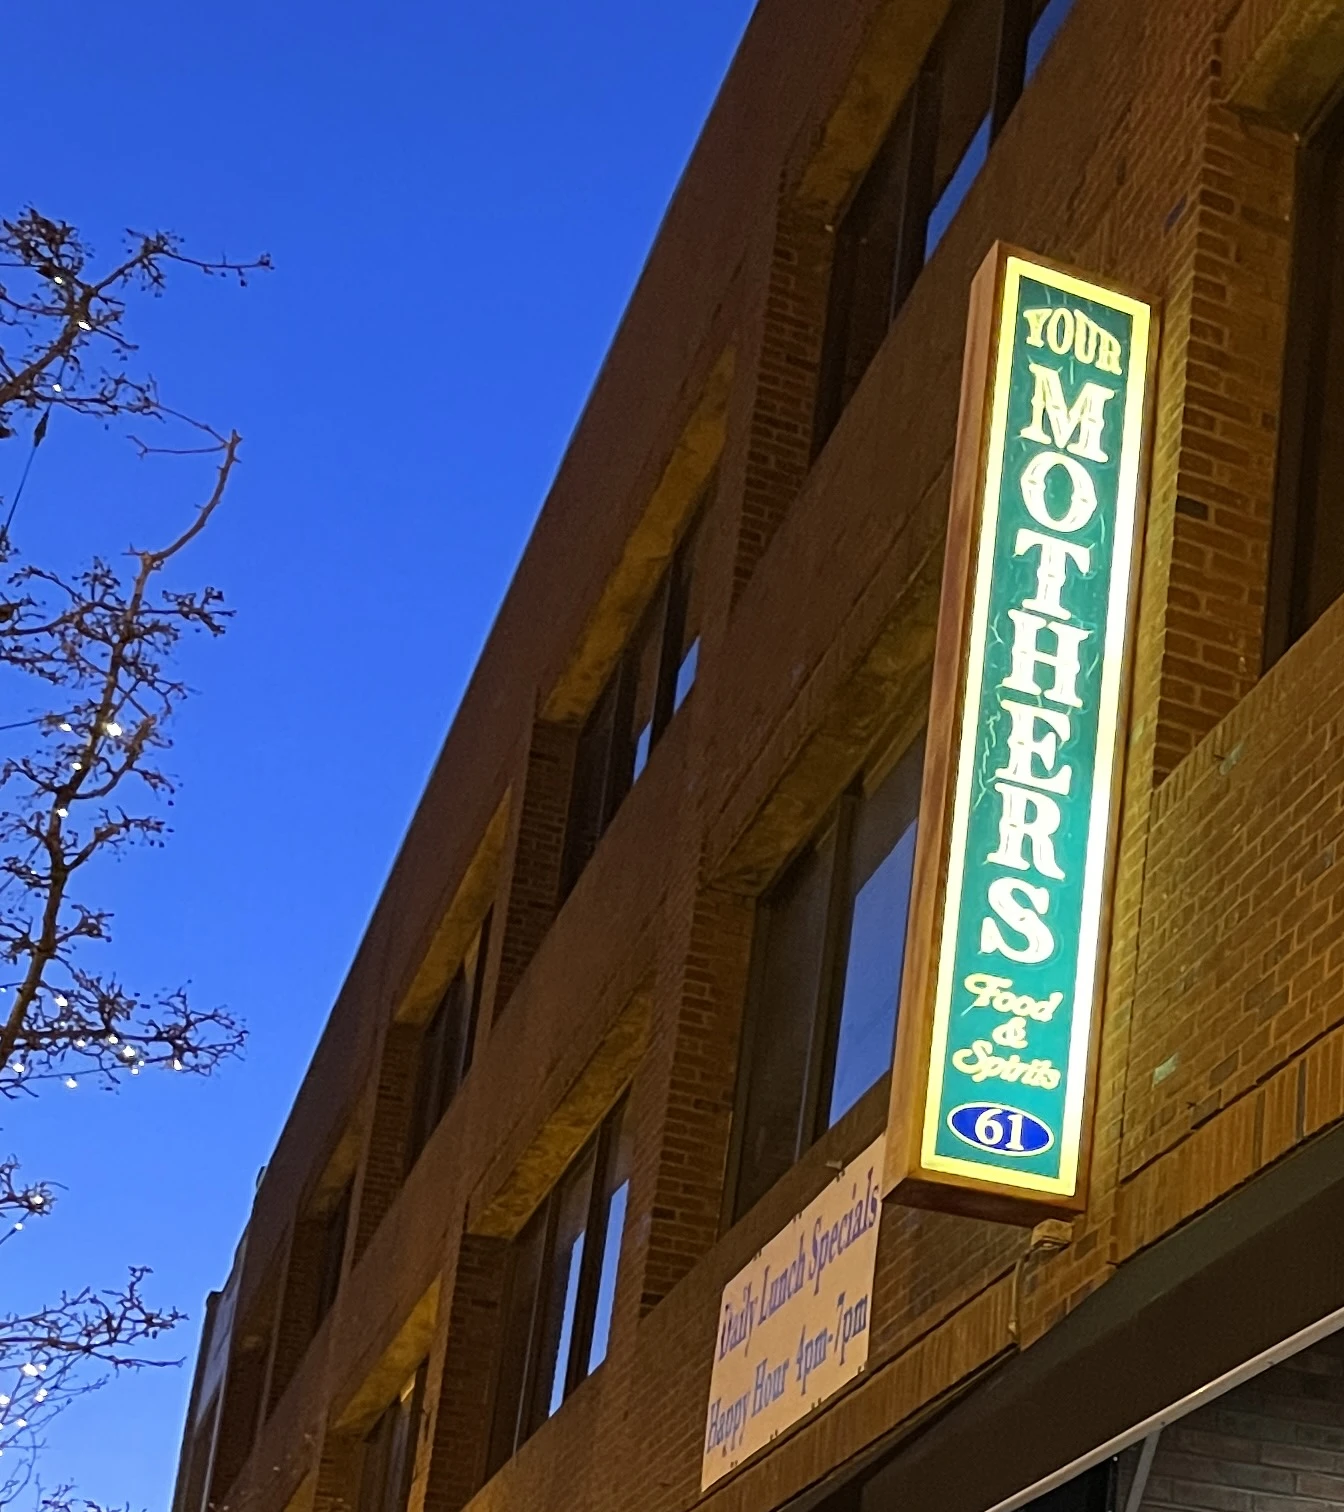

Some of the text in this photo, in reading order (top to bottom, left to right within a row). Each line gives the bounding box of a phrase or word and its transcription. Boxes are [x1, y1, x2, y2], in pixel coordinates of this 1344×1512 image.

[1022, 306, 1123, 376] YOUR
[980, 362, 1115, 964] MOTHERS
[963, 972, 1064, 1023] Food
[992, 1016, 1028, 1049] &
[952, 1039, 1061, 1090] Spirits
[974, 1108, 1025, 1151] 61
[718, 1166, 880, 1362] Daily Lunch Specials
[707, 1389, 750, 1457] Happy
[751, 1358, 790, 1419] Hour
